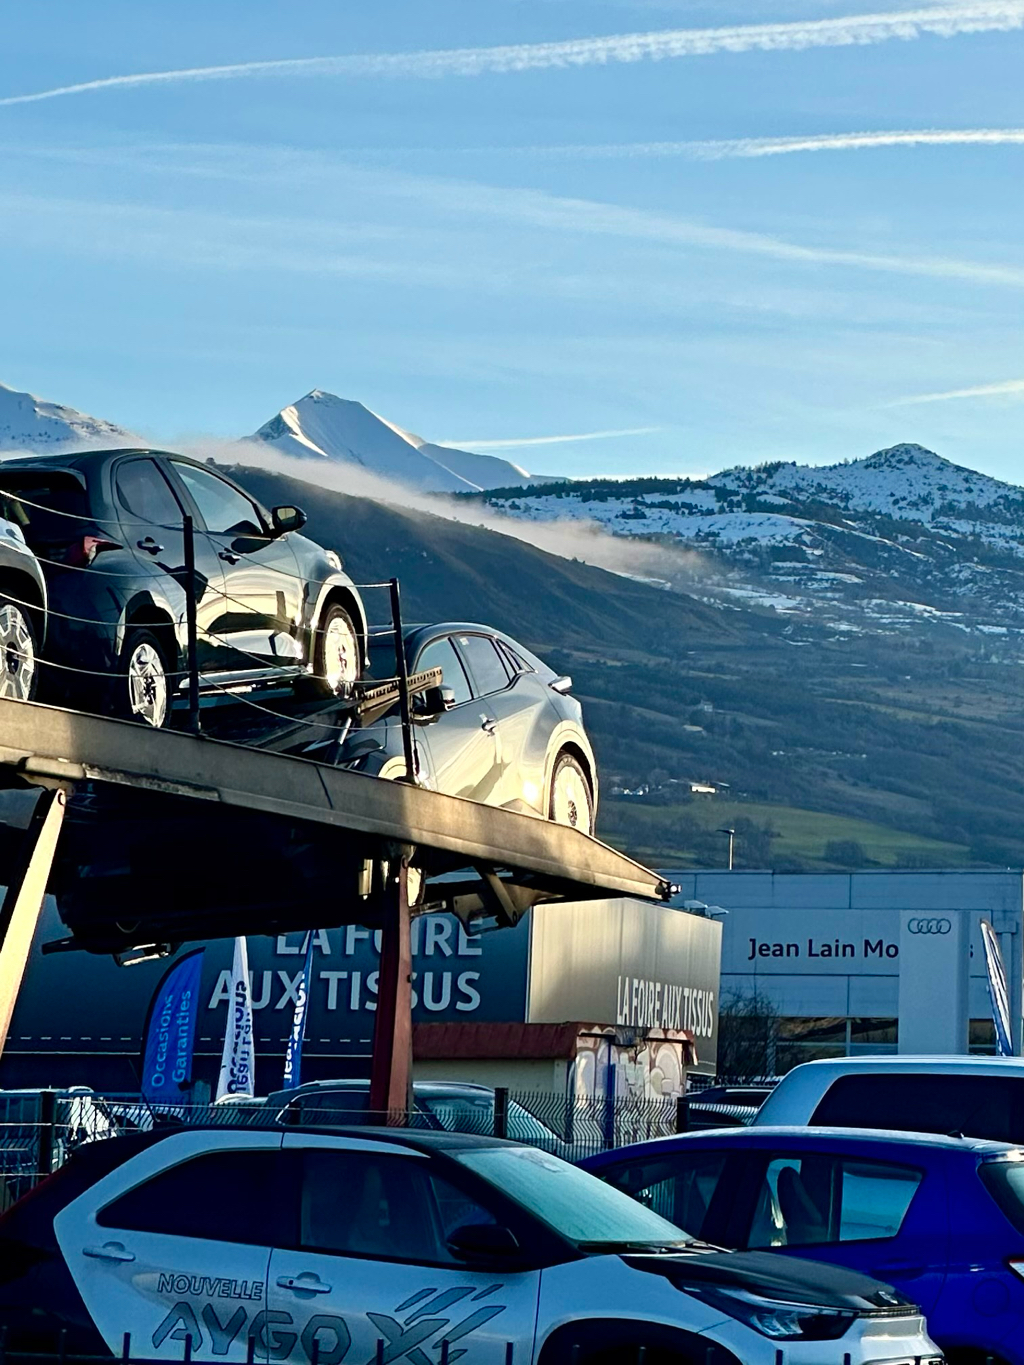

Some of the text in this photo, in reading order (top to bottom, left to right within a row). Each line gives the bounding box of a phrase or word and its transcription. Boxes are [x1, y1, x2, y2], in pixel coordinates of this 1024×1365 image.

[345, 915, 483, 956] FIRE
[748, 938, 799, 960] Jean
[808, 938, 855, 957] Lain
[208, 970, 306, 1010] AUX
[617, 975, 714, 1038] LA FOIRE AUX TISSUS
[172, 990, 191, 1083] Garanties
[157, 1272, 264, 1301] NOUVELLE
[152, 1301, 352, 1365] AYGO
